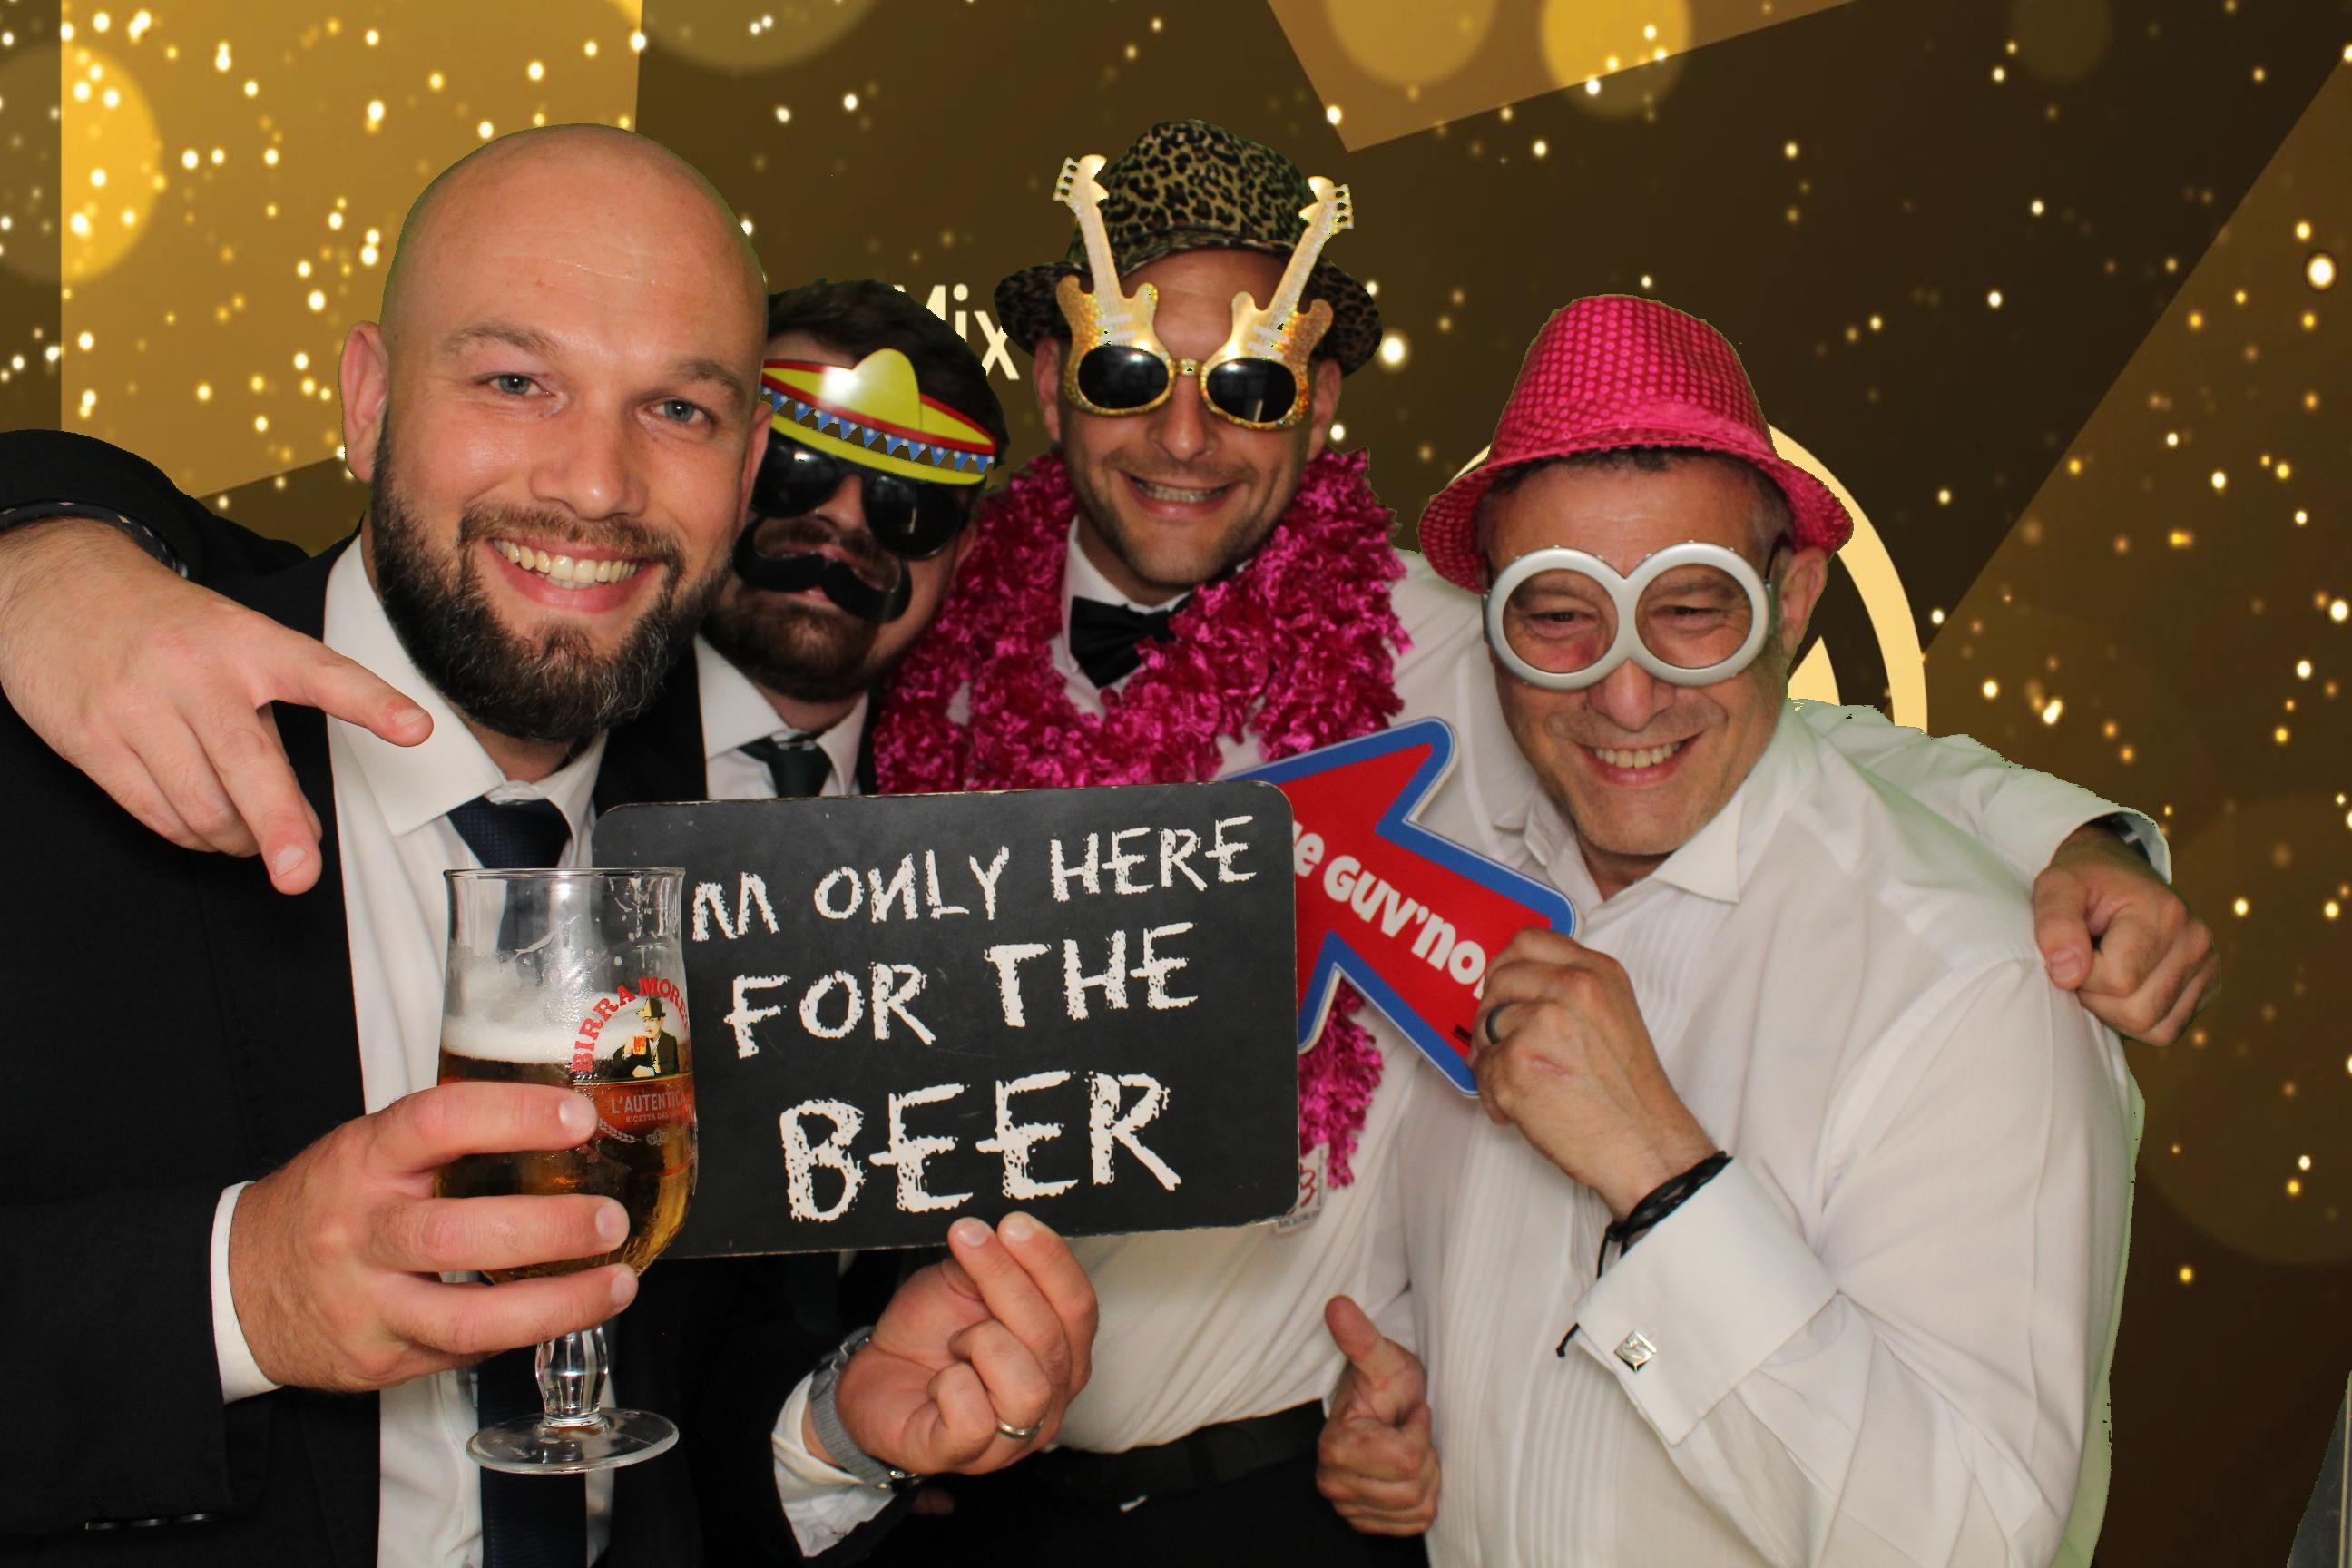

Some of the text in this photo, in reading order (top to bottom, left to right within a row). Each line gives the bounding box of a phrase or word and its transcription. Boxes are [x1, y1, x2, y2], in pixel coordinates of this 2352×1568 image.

[815, 846, 1009, 923] ONLY
[1051, 816, 1256, 901] HERE
[571, 985, 636, 1073] BIRRA
[724, 922, 1198, 1058] FOR THE
[780, 1071, 1181, 1221] BEER
